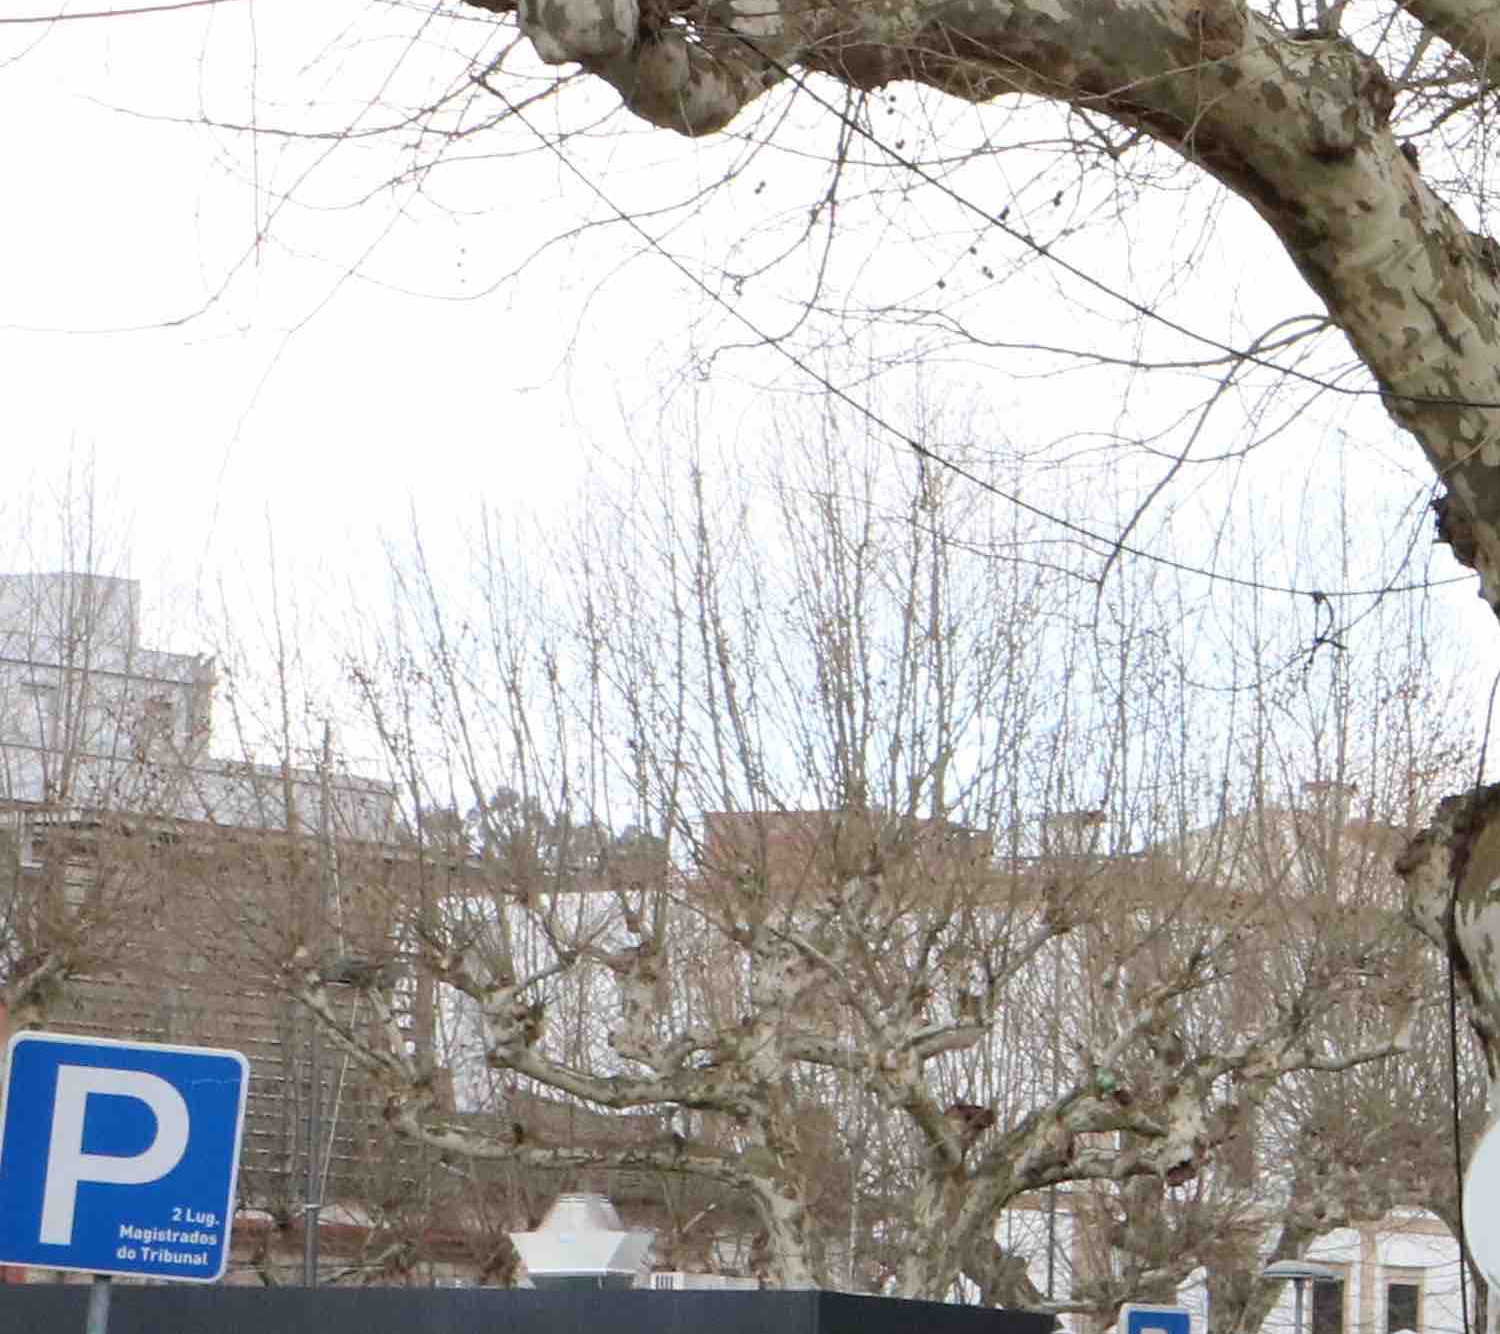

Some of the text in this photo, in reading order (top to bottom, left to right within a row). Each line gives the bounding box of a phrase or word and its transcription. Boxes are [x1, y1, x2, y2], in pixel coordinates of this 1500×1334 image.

[40, 1064, 190, 1245] P
[173, 1207, 219, 1227] 2 Lug.
[119, 1225, 217, 1245] Magistrados
[117, 1246, 208, 1265] do Tribunal
